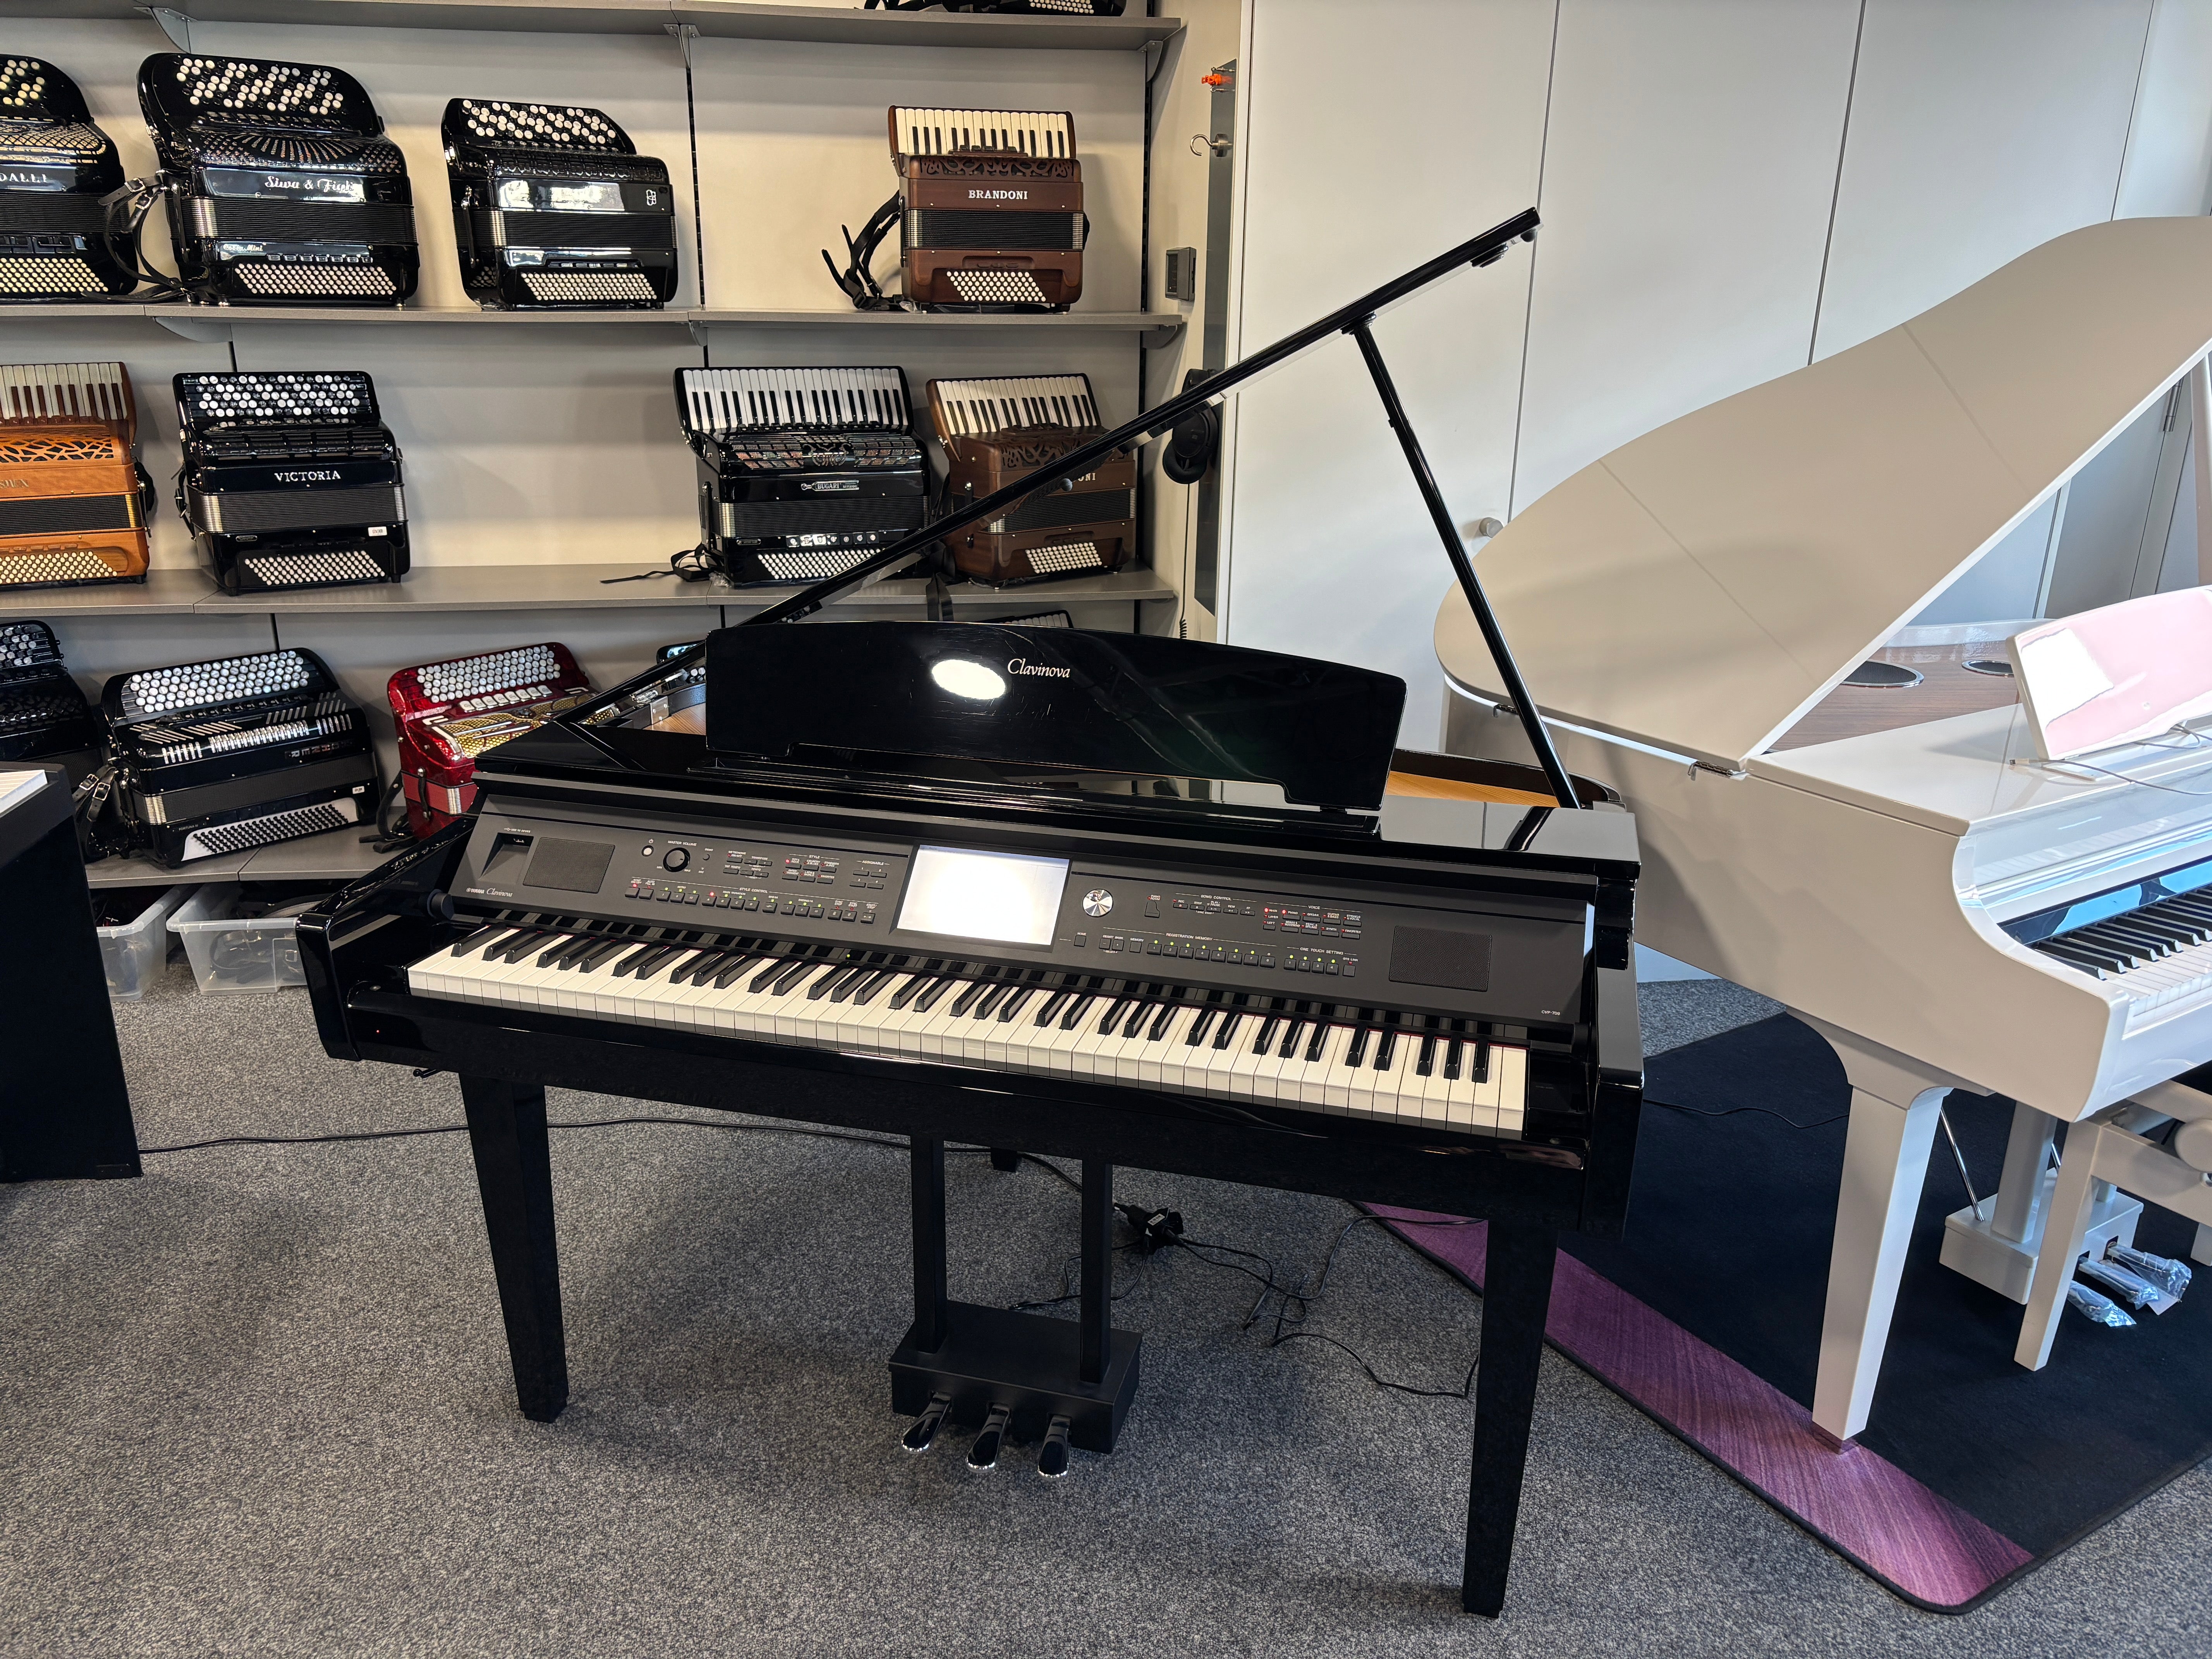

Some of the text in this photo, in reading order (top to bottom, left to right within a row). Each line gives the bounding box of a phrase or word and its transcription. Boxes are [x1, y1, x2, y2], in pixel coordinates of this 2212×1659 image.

[264, 176, 299, 189] Siwa
[304, 180, 313, 190] &
[969, 190, 1027, 200] BRANDONI
[274, 471, 341, 482] VICTORIA
[1008, 658, 1070, 678] Clavinova
[486, 888, 513, 897] Clavinova
